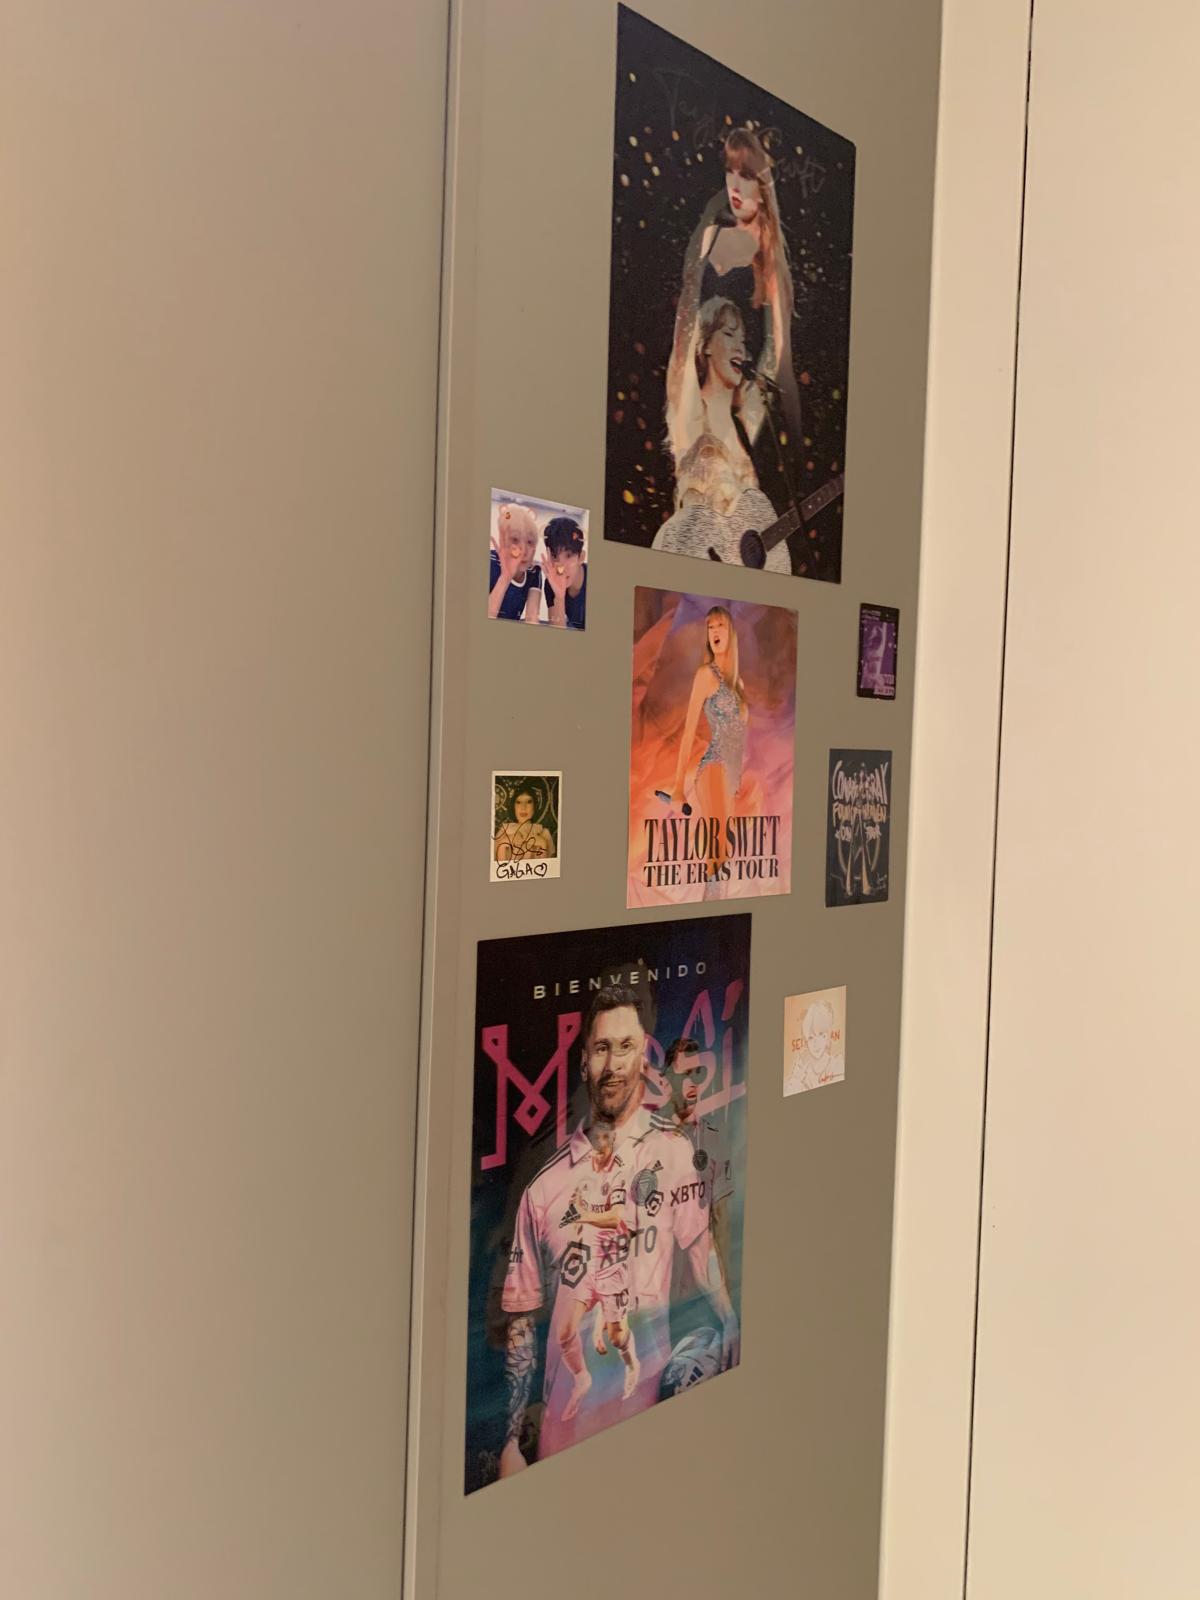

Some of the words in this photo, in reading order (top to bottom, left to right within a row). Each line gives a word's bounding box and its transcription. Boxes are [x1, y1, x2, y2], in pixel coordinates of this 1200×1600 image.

[644, 817, 720, 863] TAYLOR
[725, 815, 781, 859] SWIFT
[496, 862, 533, 879] GAGA
[643, 864, 682, 888] THE
[686, 860, 731, 884] ERAS
[735, 858, 779, 880] TOUR
[533, 961, 707, 1000] BIENVENIDO
[670, 1182, 706, 1207] XBTO
[600, 1225, 658, 1269] XBTO
